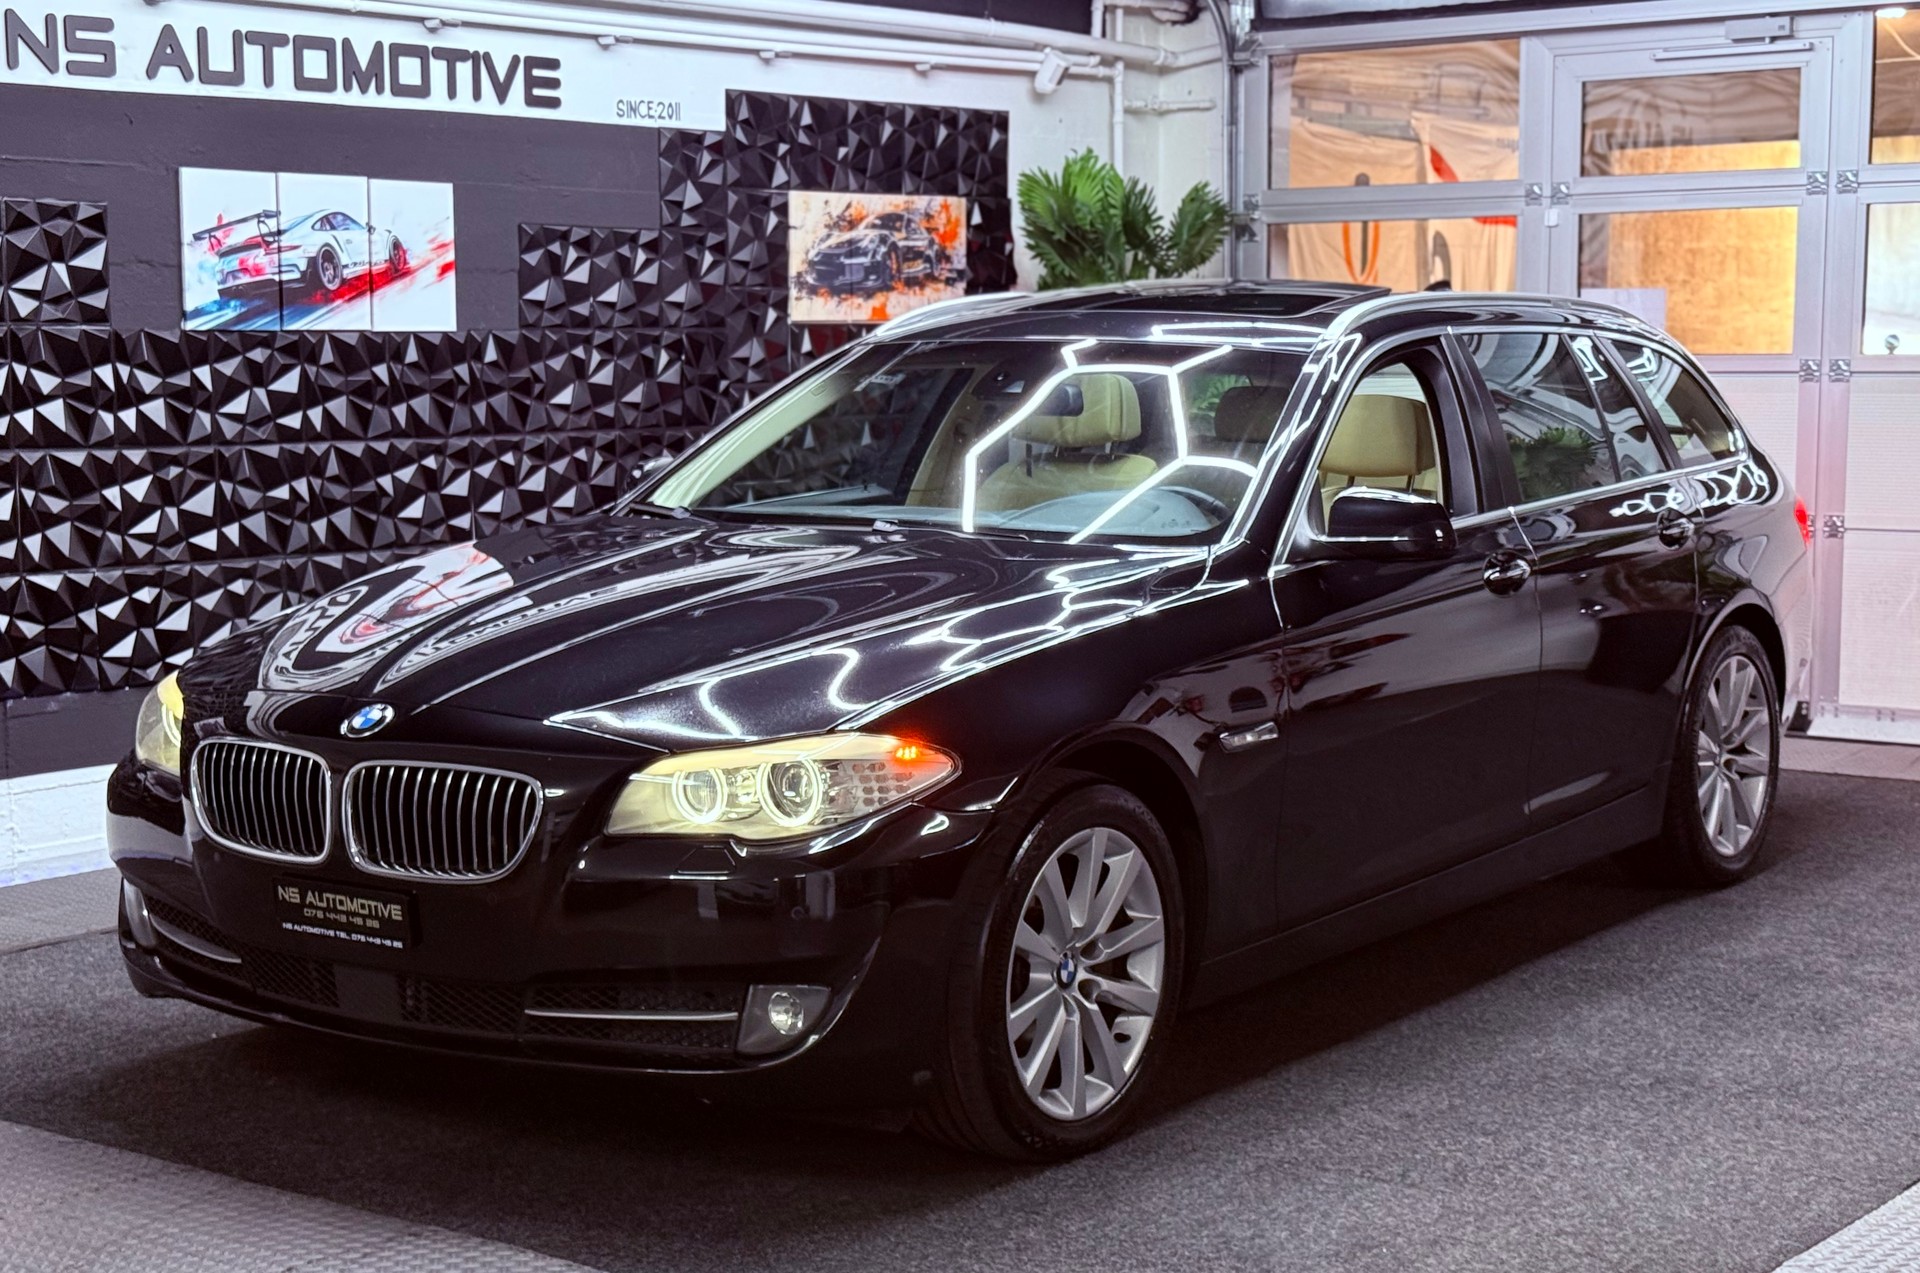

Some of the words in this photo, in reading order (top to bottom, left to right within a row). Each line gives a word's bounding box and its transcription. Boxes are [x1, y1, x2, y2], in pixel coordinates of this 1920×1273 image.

[4, 8, 117, 78] NS
[146, 23, 562, 110] AUTOMOTIVE
[277, 885, 300, 904] NS
[306, 890, 403, 921] AUTOMOTIVE
[293, 924, 335, 937] AUTOMOTIVE
